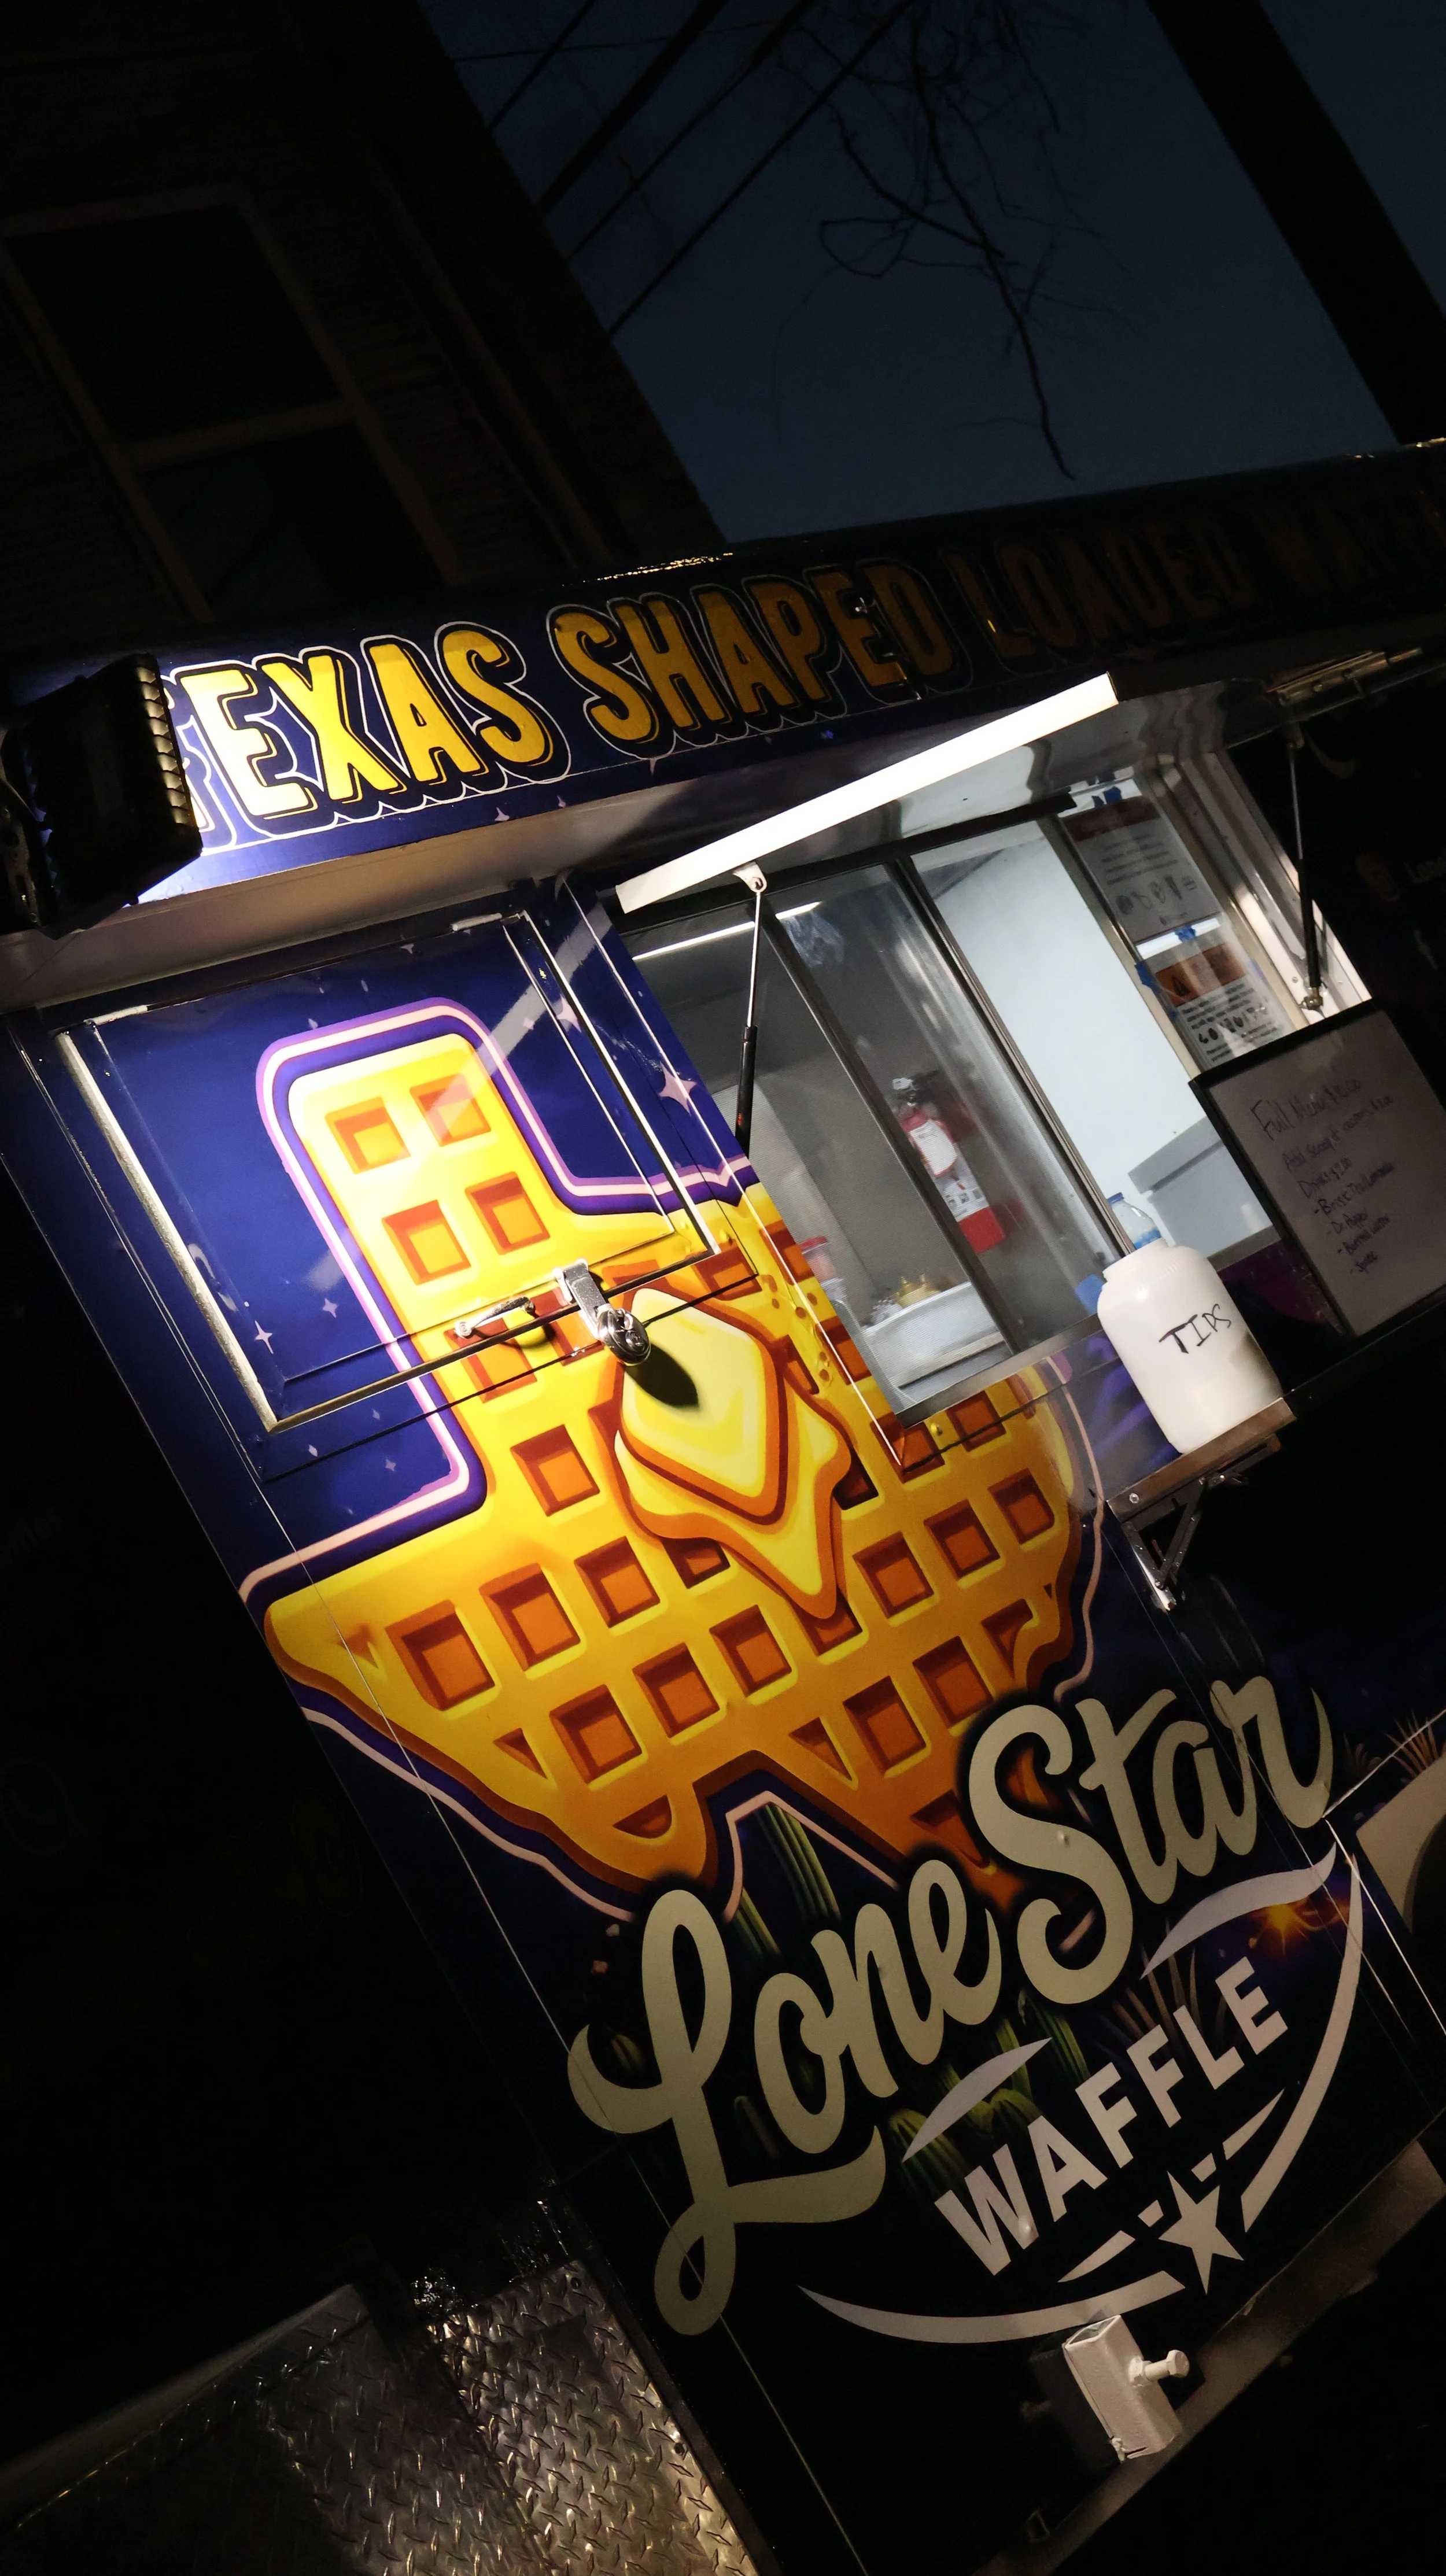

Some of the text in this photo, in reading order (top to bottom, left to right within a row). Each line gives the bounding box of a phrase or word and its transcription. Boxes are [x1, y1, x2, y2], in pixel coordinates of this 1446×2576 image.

[171, 625, 561, 839] EXAS
[551, 561, 965, 744] SHAPED
[941, 512, 1256, 659] LOADED
[1159, 1303, 1231, 1354] TIPS
[567, 1675, 1334, 2337] Lone Star
[934, 1955, 1288, 2277] WAFFLE
